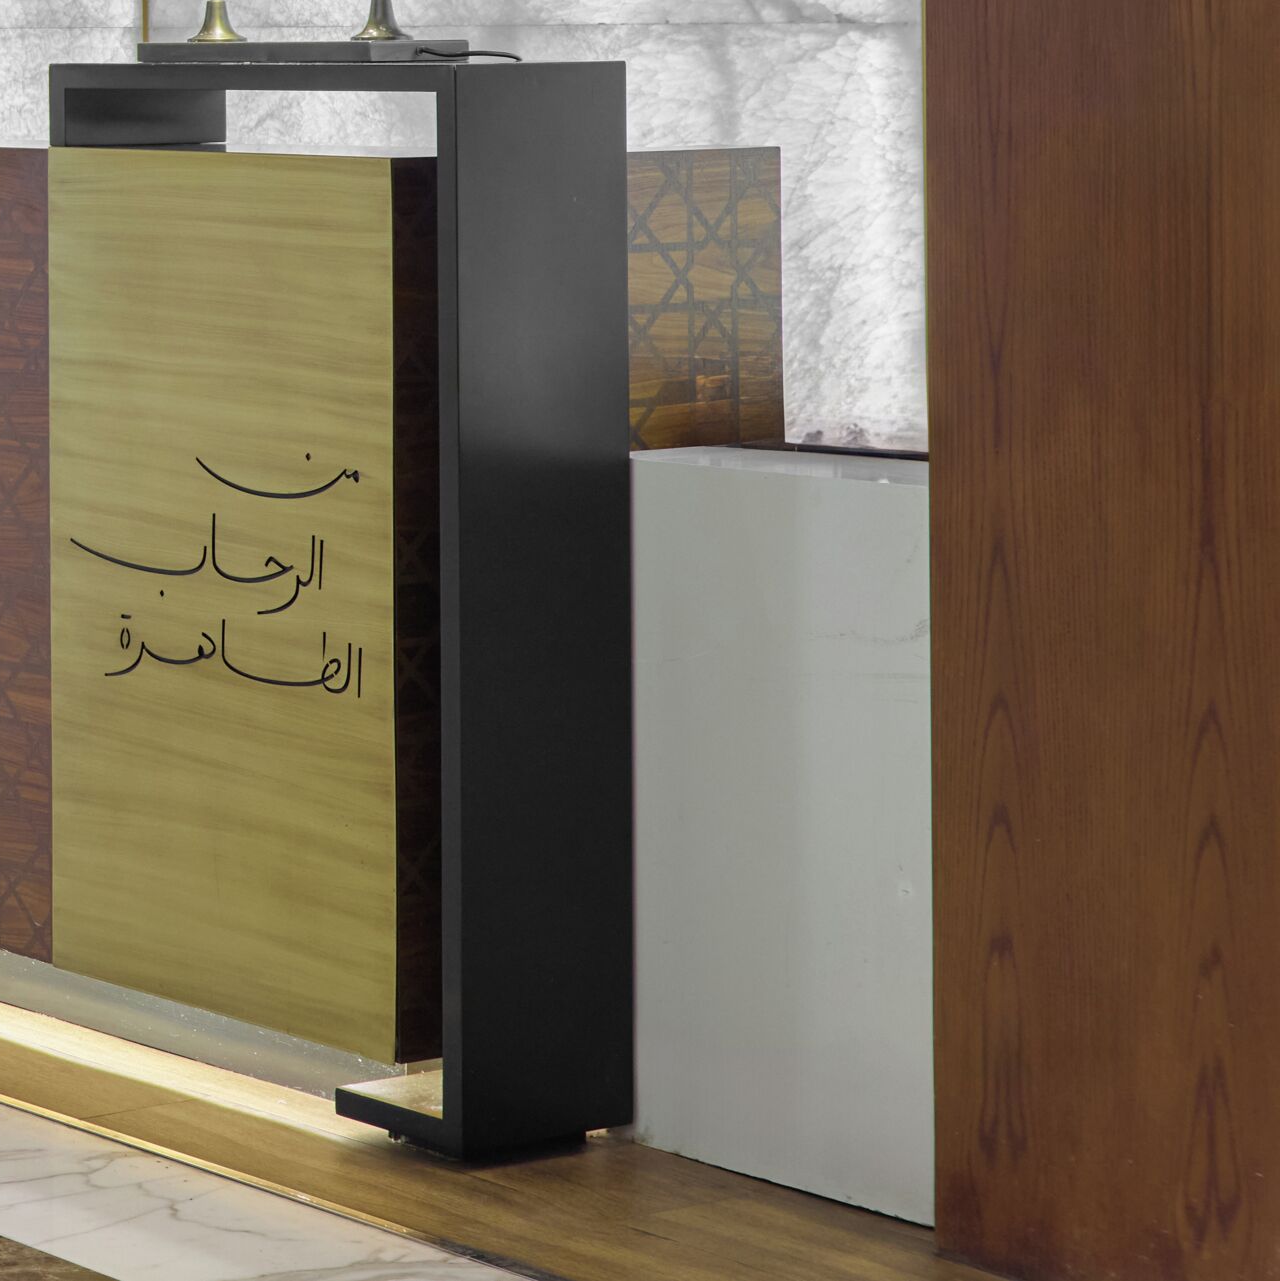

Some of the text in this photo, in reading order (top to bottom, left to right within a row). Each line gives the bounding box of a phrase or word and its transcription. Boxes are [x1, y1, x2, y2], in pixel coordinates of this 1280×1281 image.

[195, 451, 361, 499] من
[69, 512, 325, 616] الرحاب
[104, 613, 364, 699] الطاهرة
